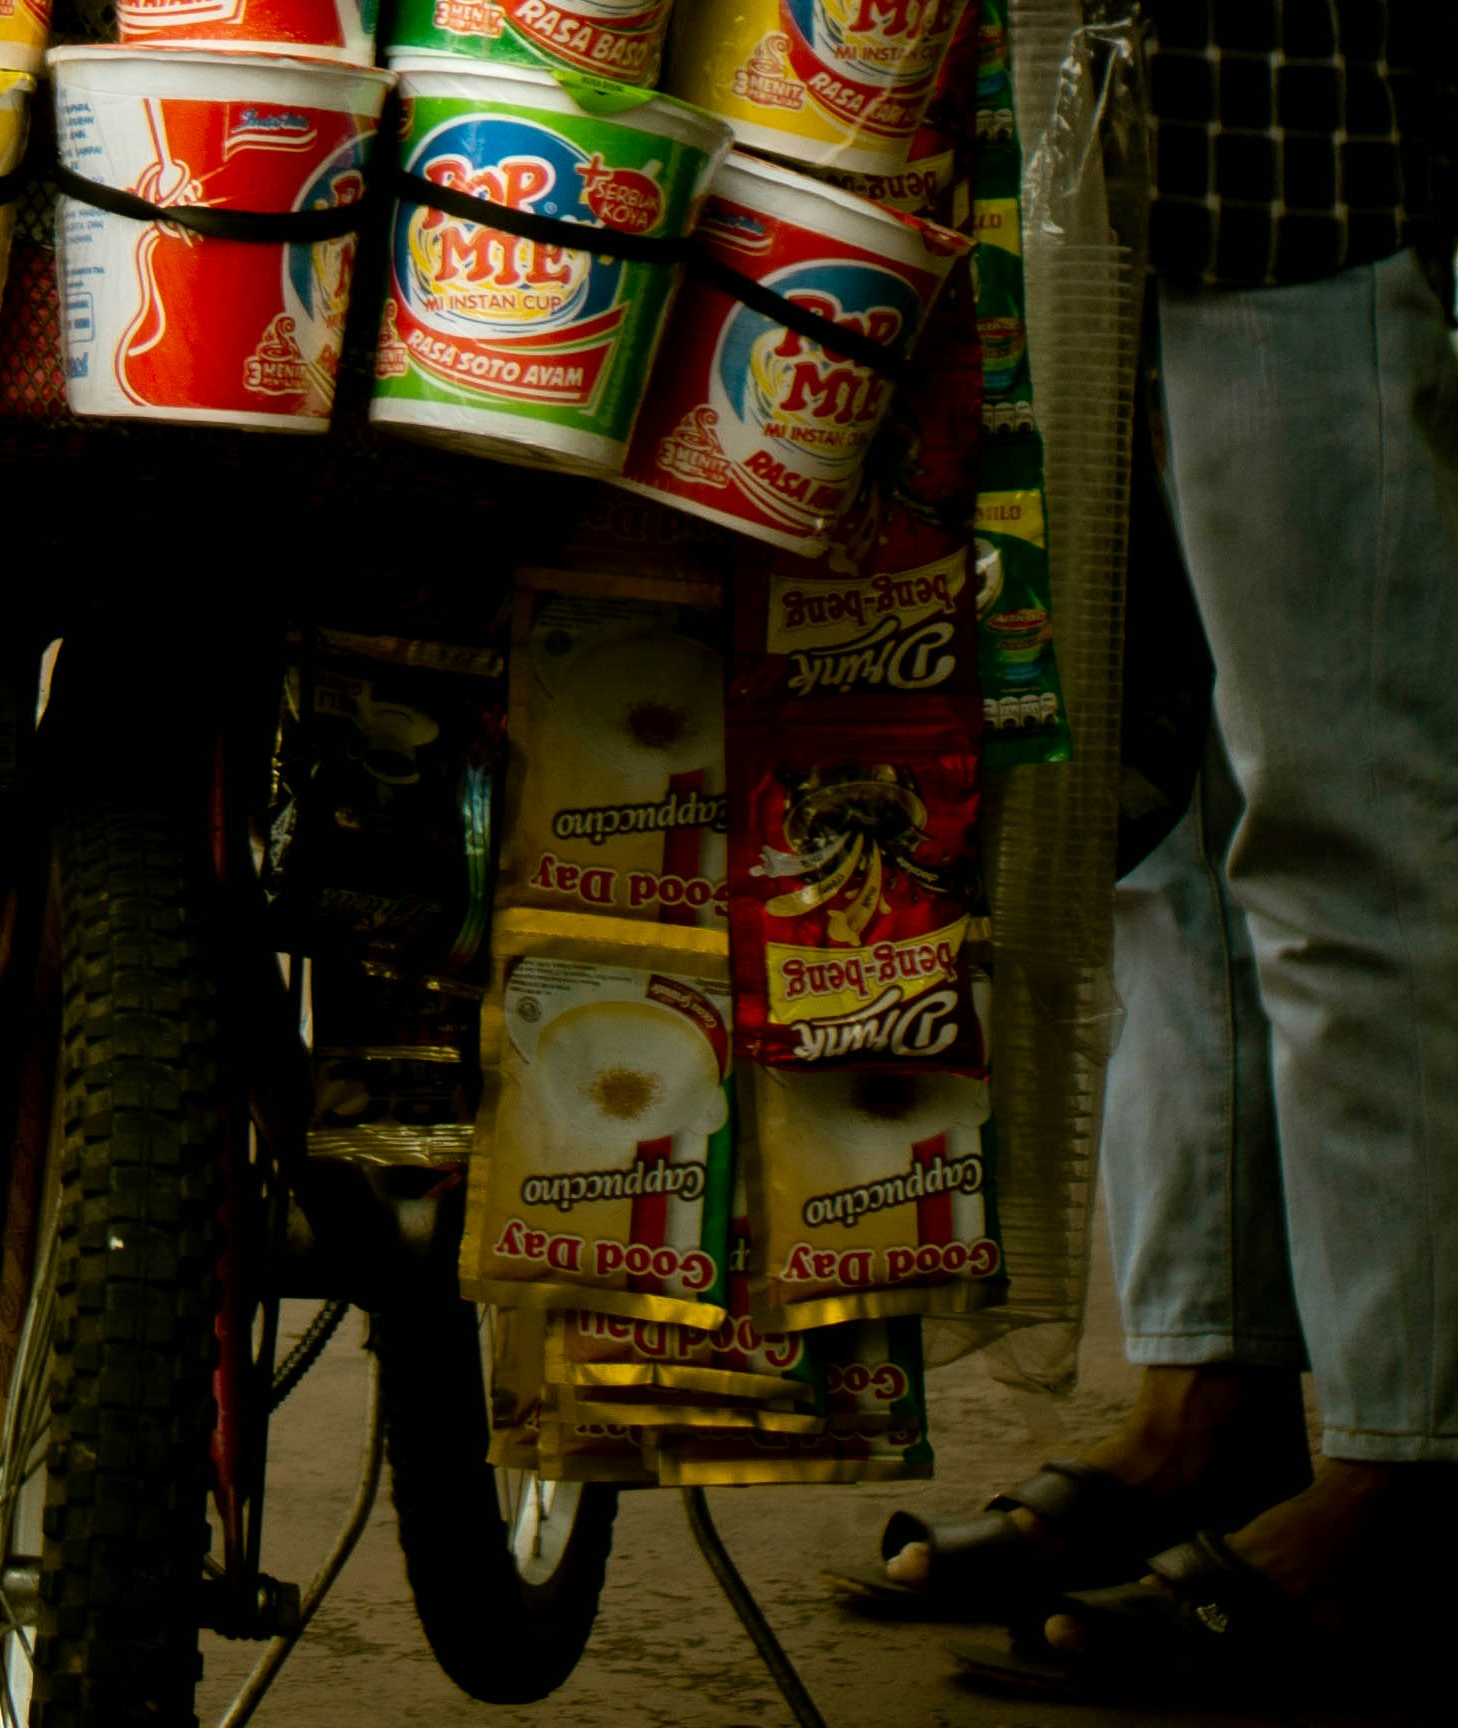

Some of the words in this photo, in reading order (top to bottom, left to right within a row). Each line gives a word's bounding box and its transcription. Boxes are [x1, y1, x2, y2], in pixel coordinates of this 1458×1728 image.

[807, 71, 866, 113] RASA
[599, 204, 650, 229] KOYA
[435, 227, 572, 288] MIE
[425, 297, 443, 312] MI
[448, 294, 516, 311] INSTAN
[522, 294, 563, 312] CUP
[247, 358, 262, 385] 3
[408, 329, 456, 368] RASA
[456, 354, 523, 383] SOTO
[526, 364, 584, 389] AYAM
[742, 448, 812, 507] RASA
[786, 615, 957, 697] Drink
[527, 852, 615, 904] Day
[782, 940, 957, 1001] beng-beng
[791, 984, 960, 1062] Drink
[519, 1156, 708, 1215] Cappuccino
[802, 1154, 986, 1230] Cappuccino
[494, 1217, 583, 1275] Day
[595, 1241, 716, 1292] Good
[779, 1242, 876, 1288] Day
[886, 1238, 1002, 1286] Good
